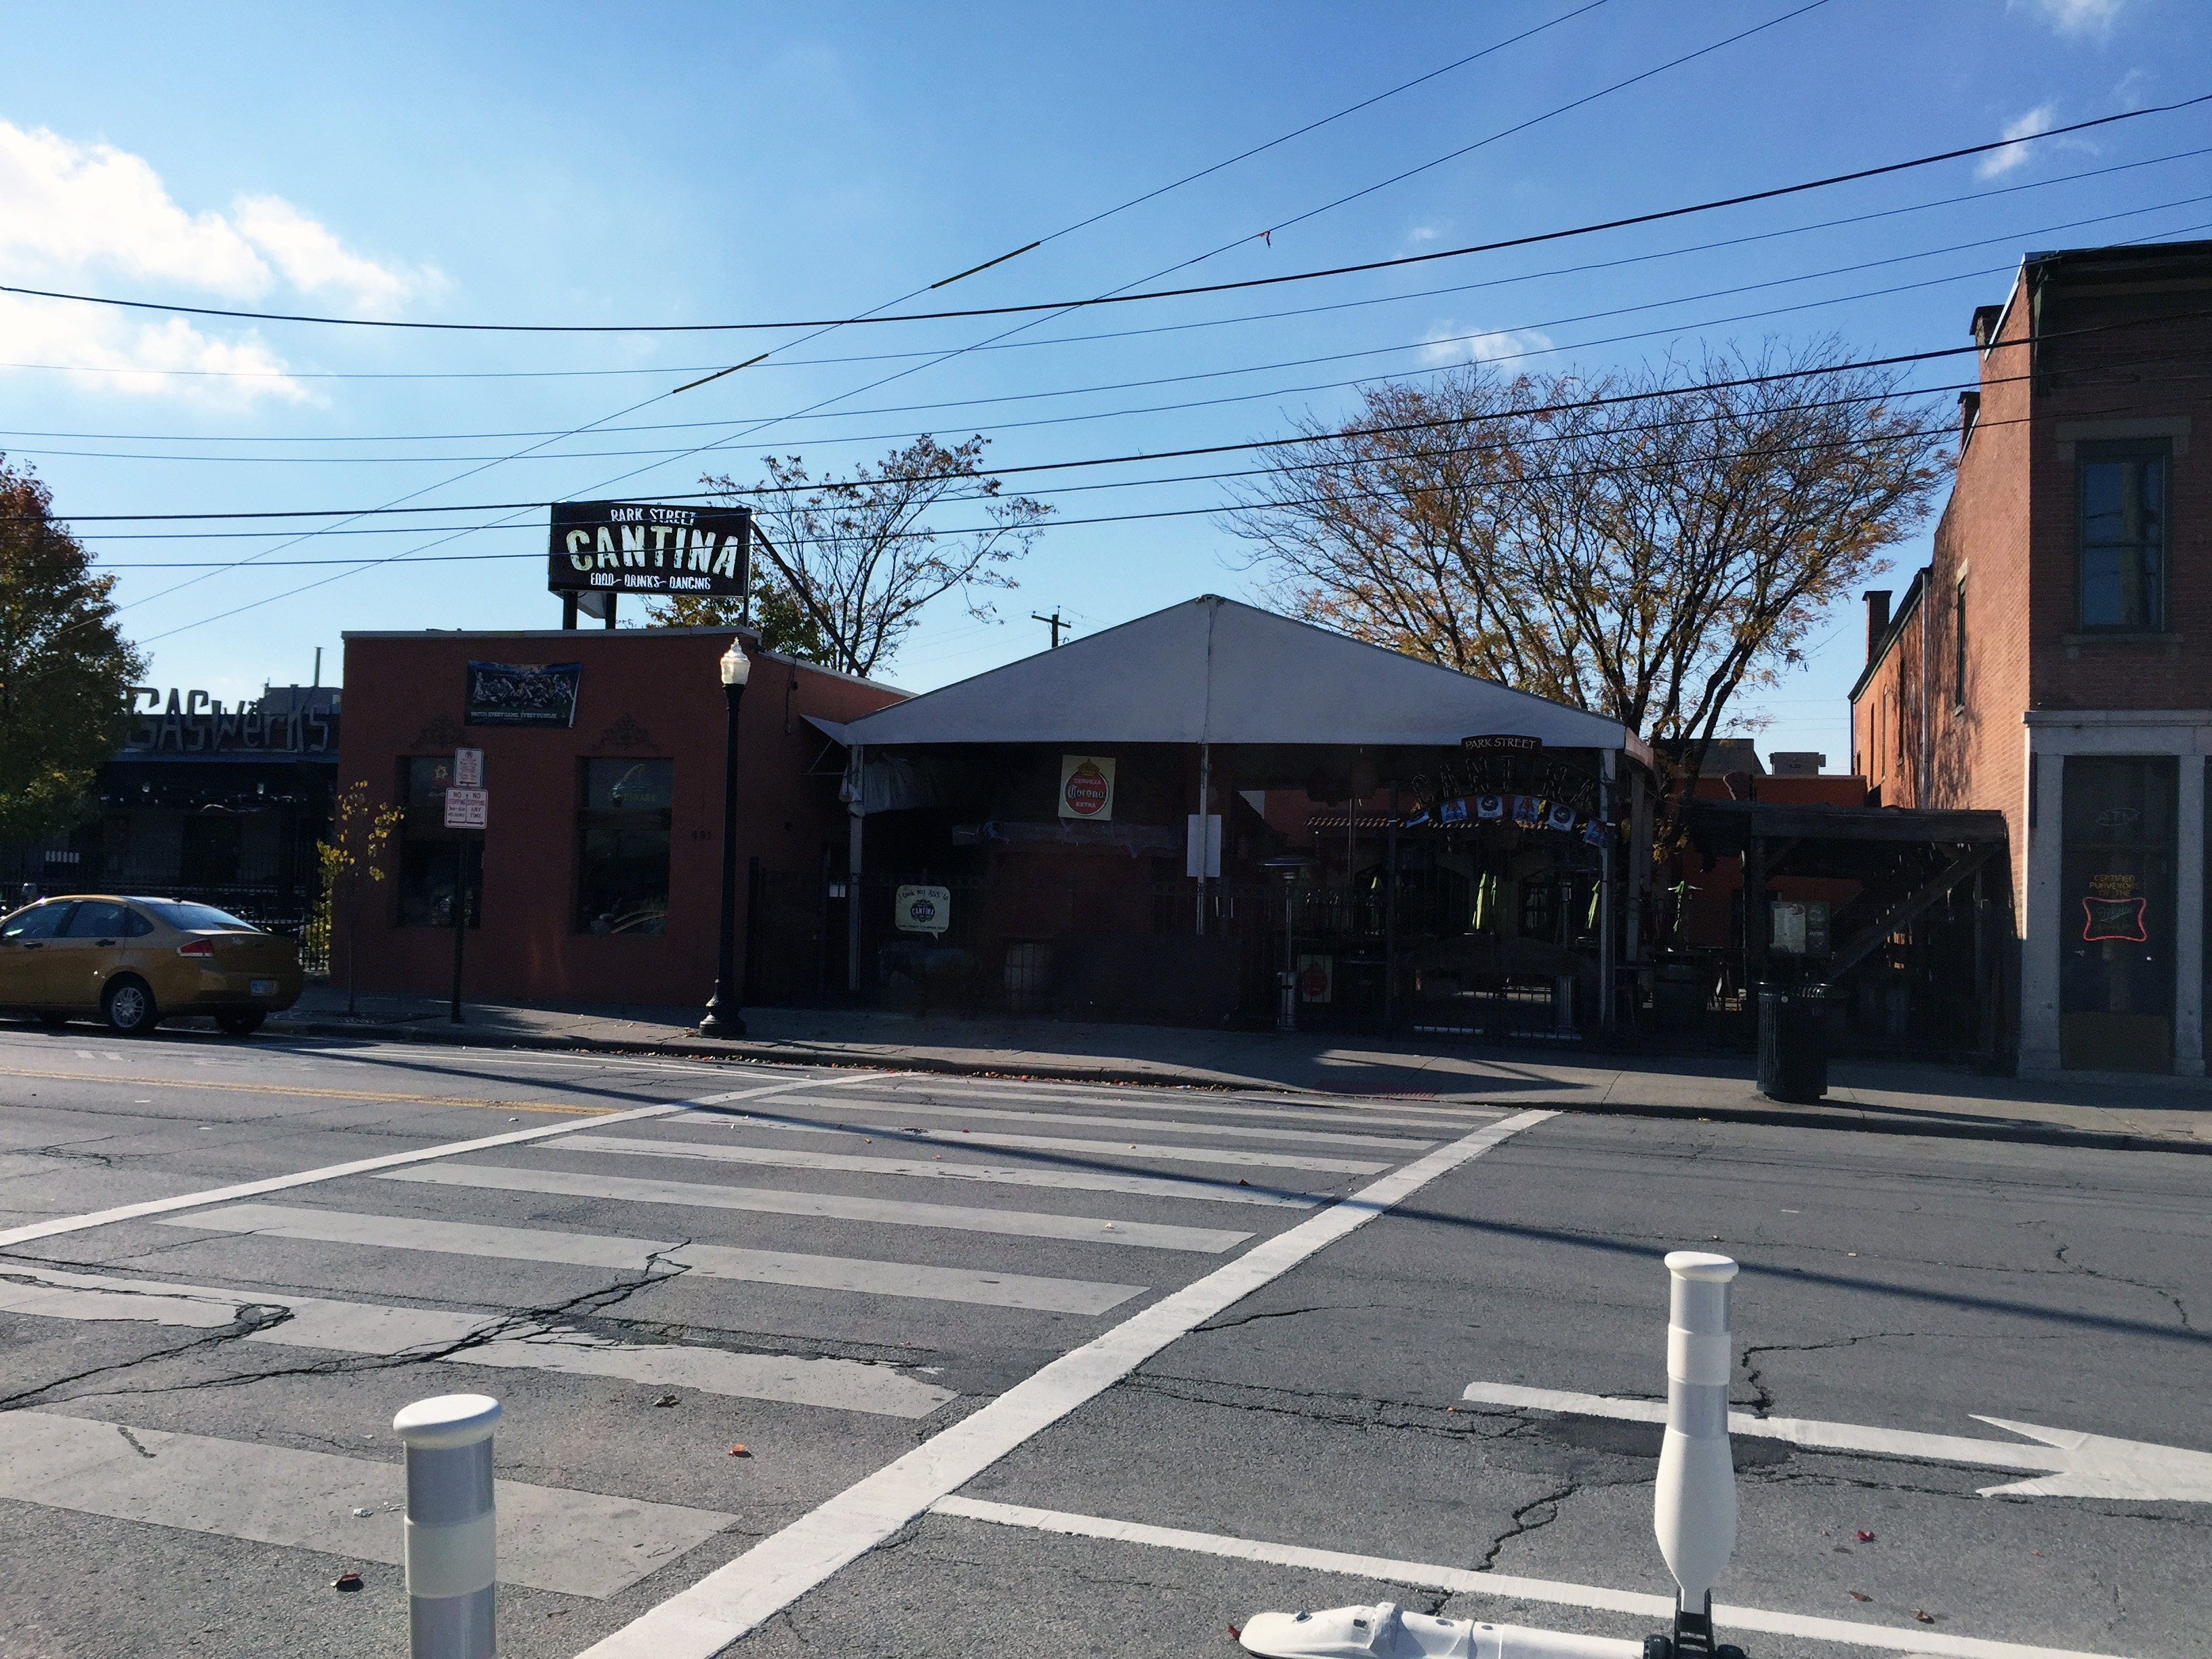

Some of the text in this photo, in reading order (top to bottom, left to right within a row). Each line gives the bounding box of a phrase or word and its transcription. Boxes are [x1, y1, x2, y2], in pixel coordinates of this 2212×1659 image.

[611, 508, 697, 525] PARK STREET
[566, 525, 739, 579] CANTINA
[670, 575, 711, 590] DANCING
[1465, 737, 1536, 750] PARK STREET
[1067, 785, 1104, 798] Corona
[928, 890, 941, 898] ASS
